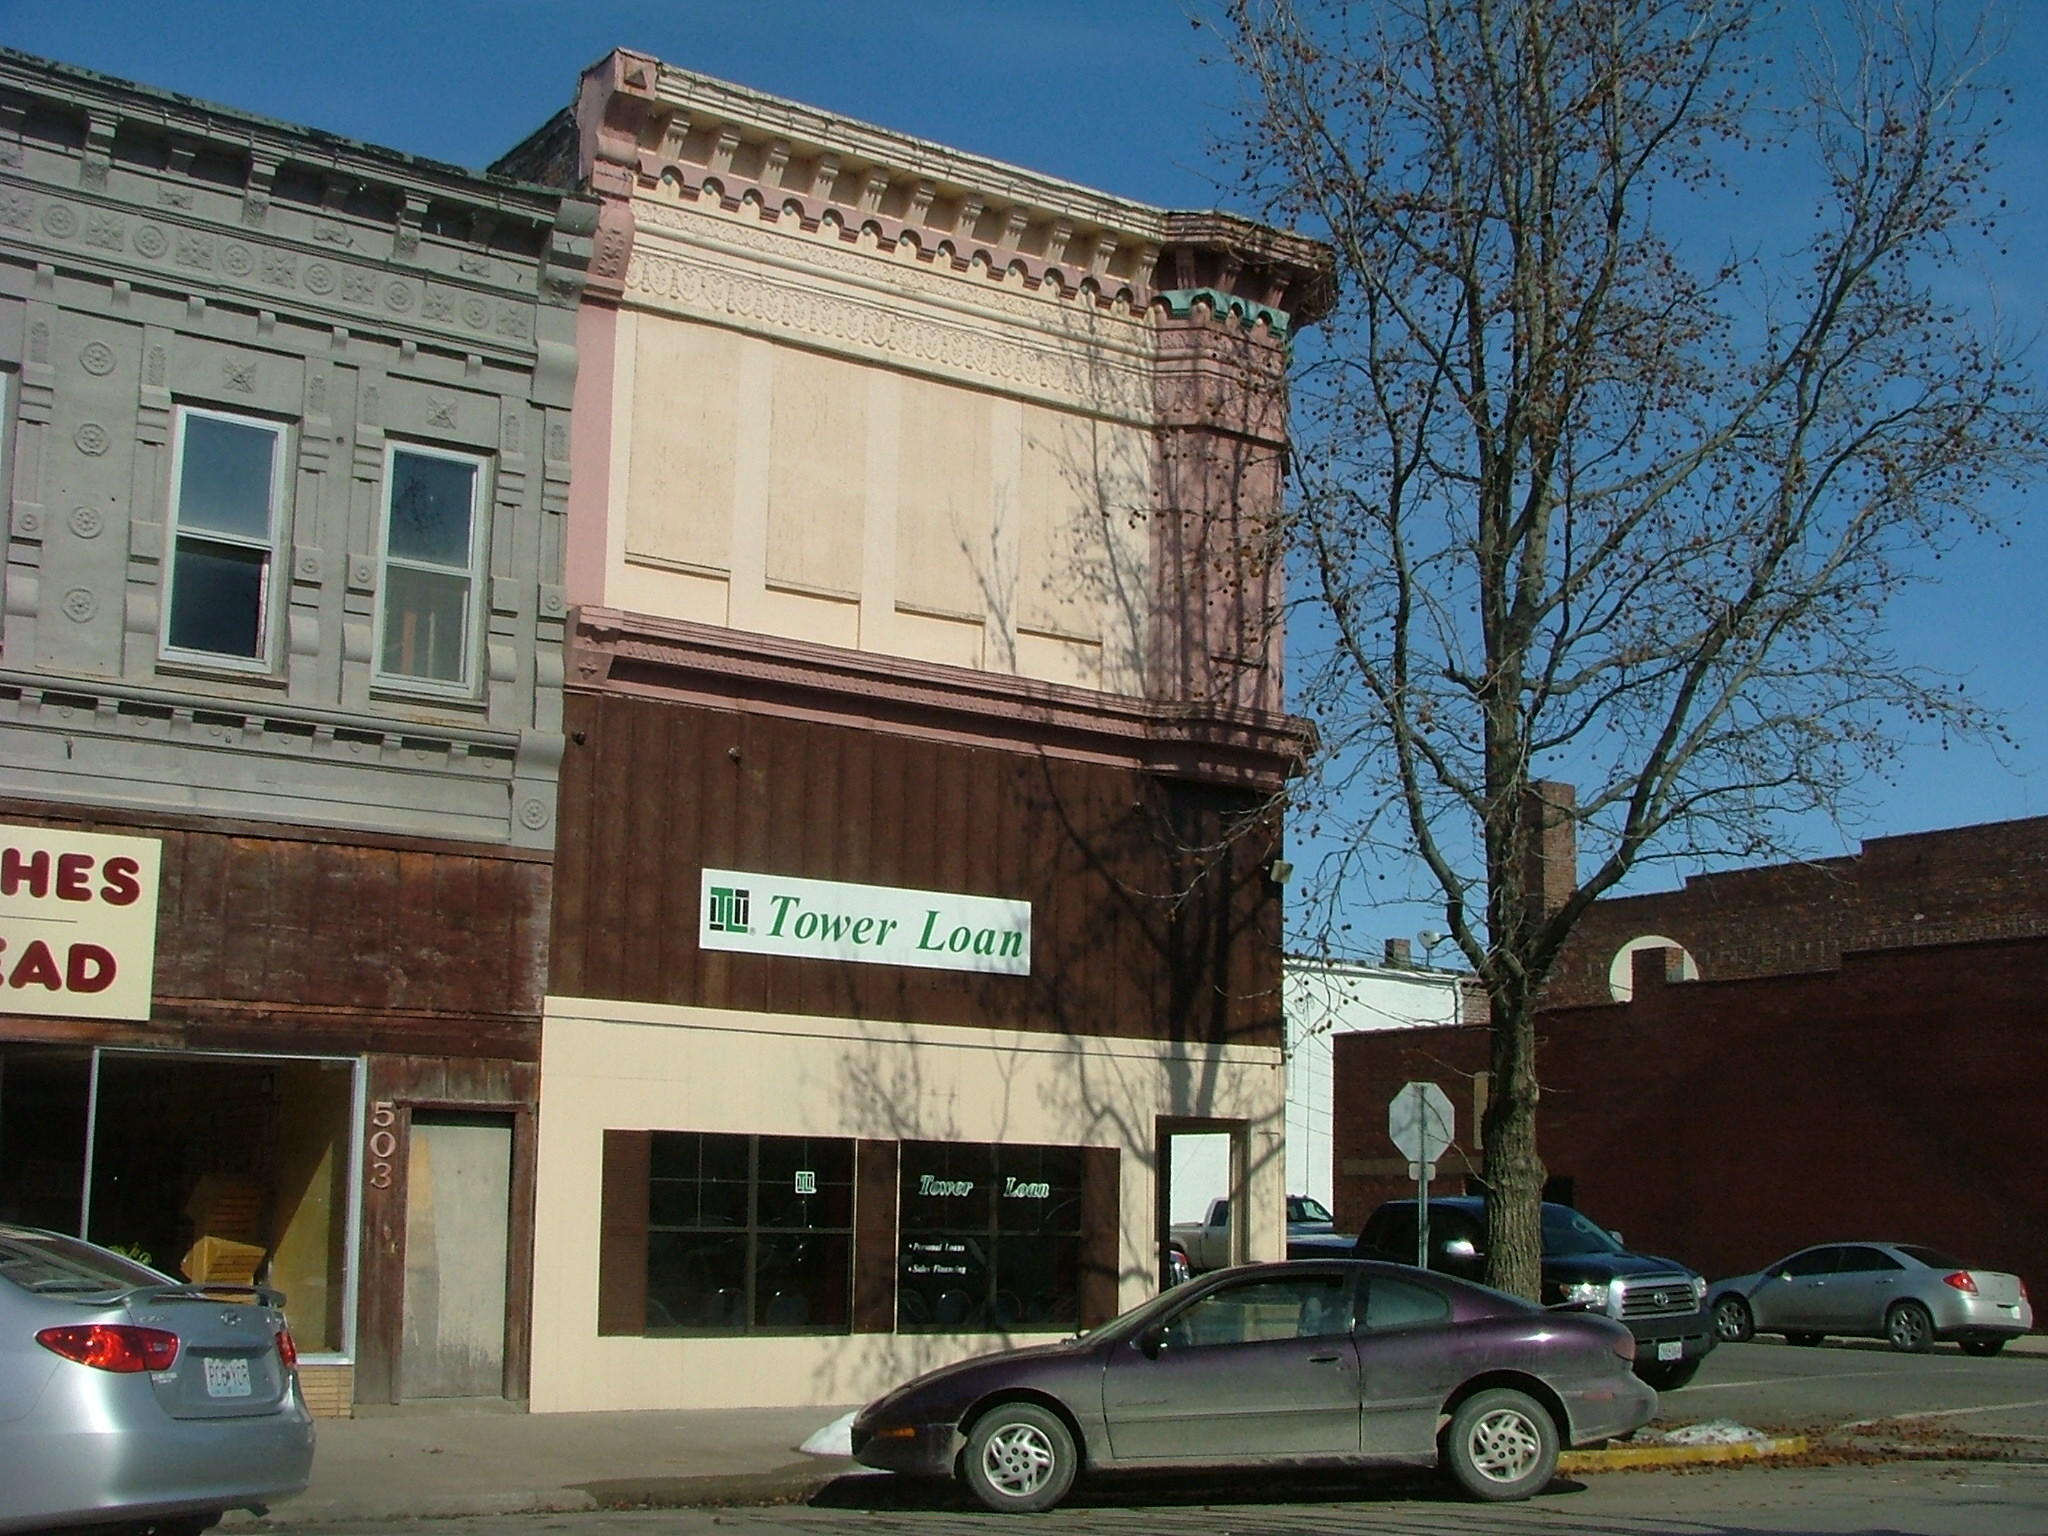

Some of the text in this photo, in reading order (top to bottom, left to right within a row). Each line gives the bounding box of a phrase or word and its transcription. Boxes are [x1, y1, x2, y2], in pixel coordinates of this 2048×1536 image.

[766, 895, 898, 946] Tower
[916, 910, 1024, 958] Loan
[0, 937, 117, 993] AD
[370, 1101, 396, 1189] 503
[918, 1174, 974, 1197] Tower
[1003, 1176, 1050, 1199] Loan
